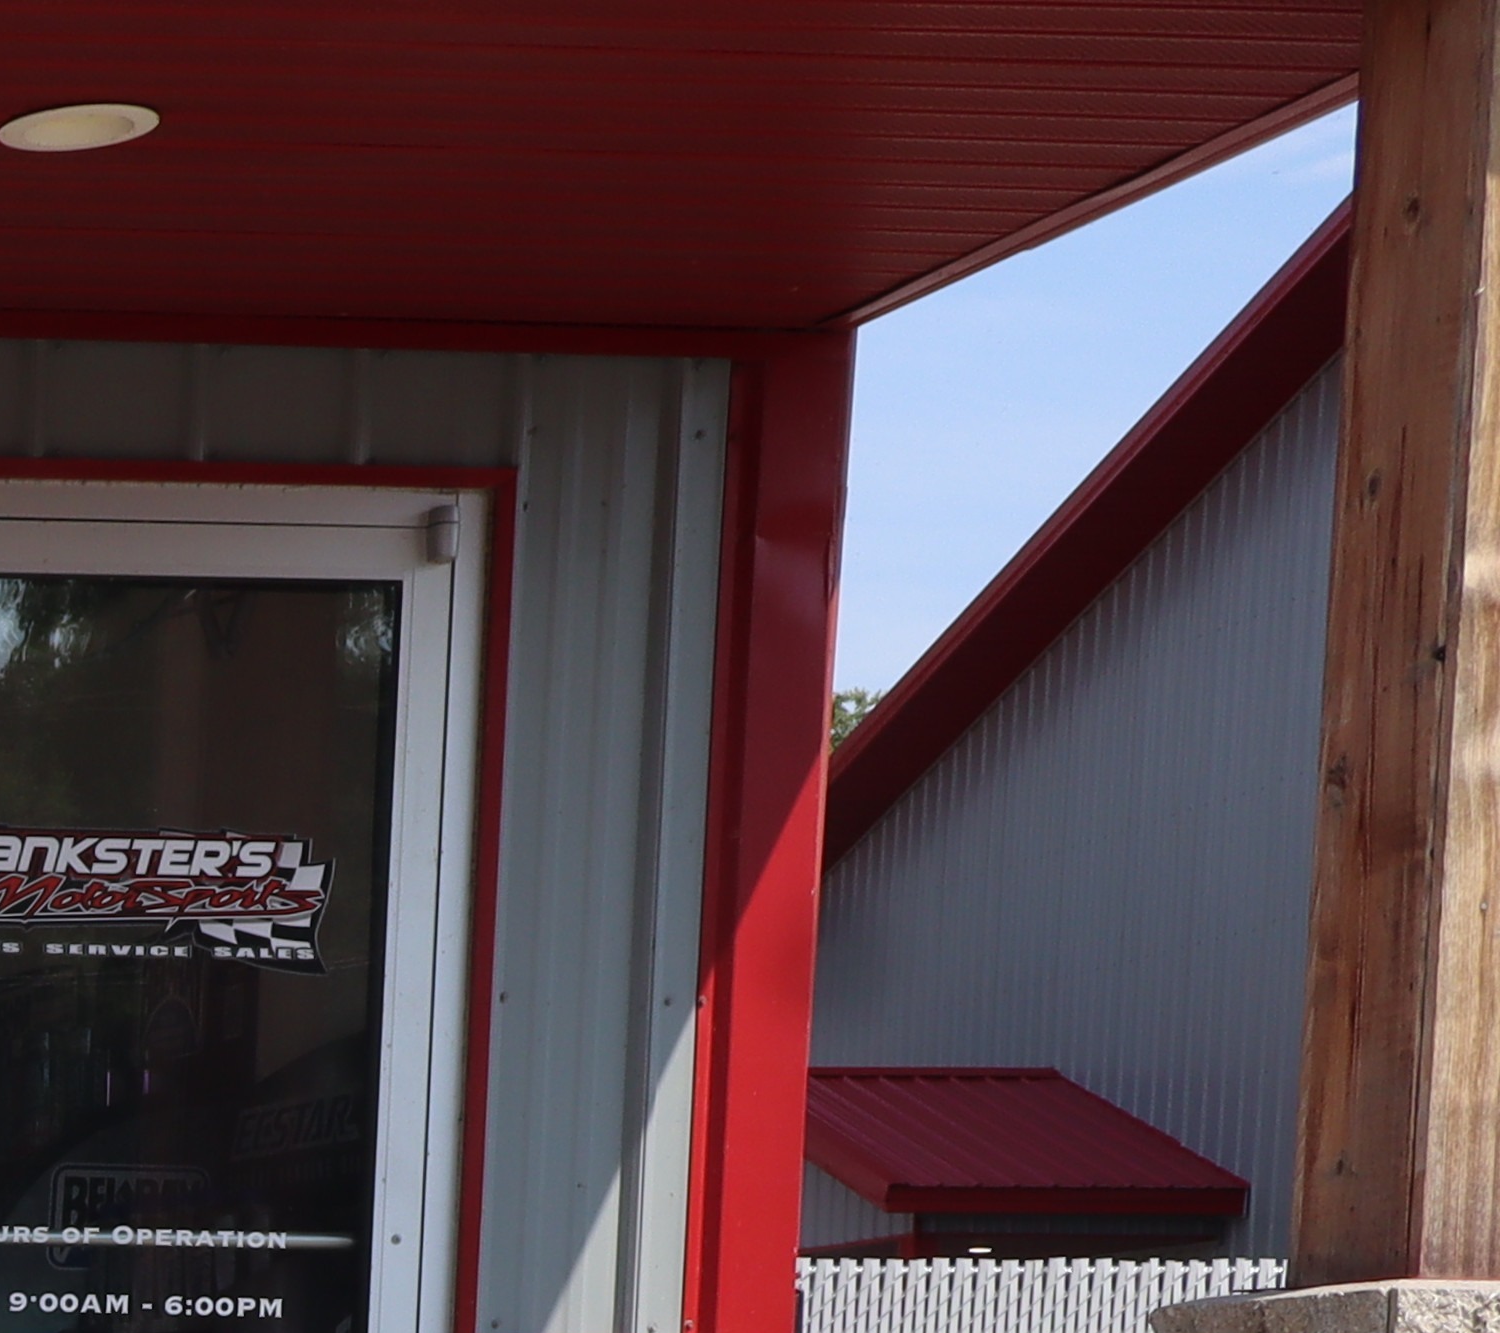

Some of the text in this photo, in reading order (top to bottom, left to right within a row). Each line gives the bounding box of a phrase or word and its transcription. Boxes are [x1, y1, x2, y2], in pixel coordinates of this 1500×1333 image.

[46, 943, 189, 958] SERVICE
[213, 945, 315, 961] SALES
[164, 1295, 283, 1318] 6:00PM
